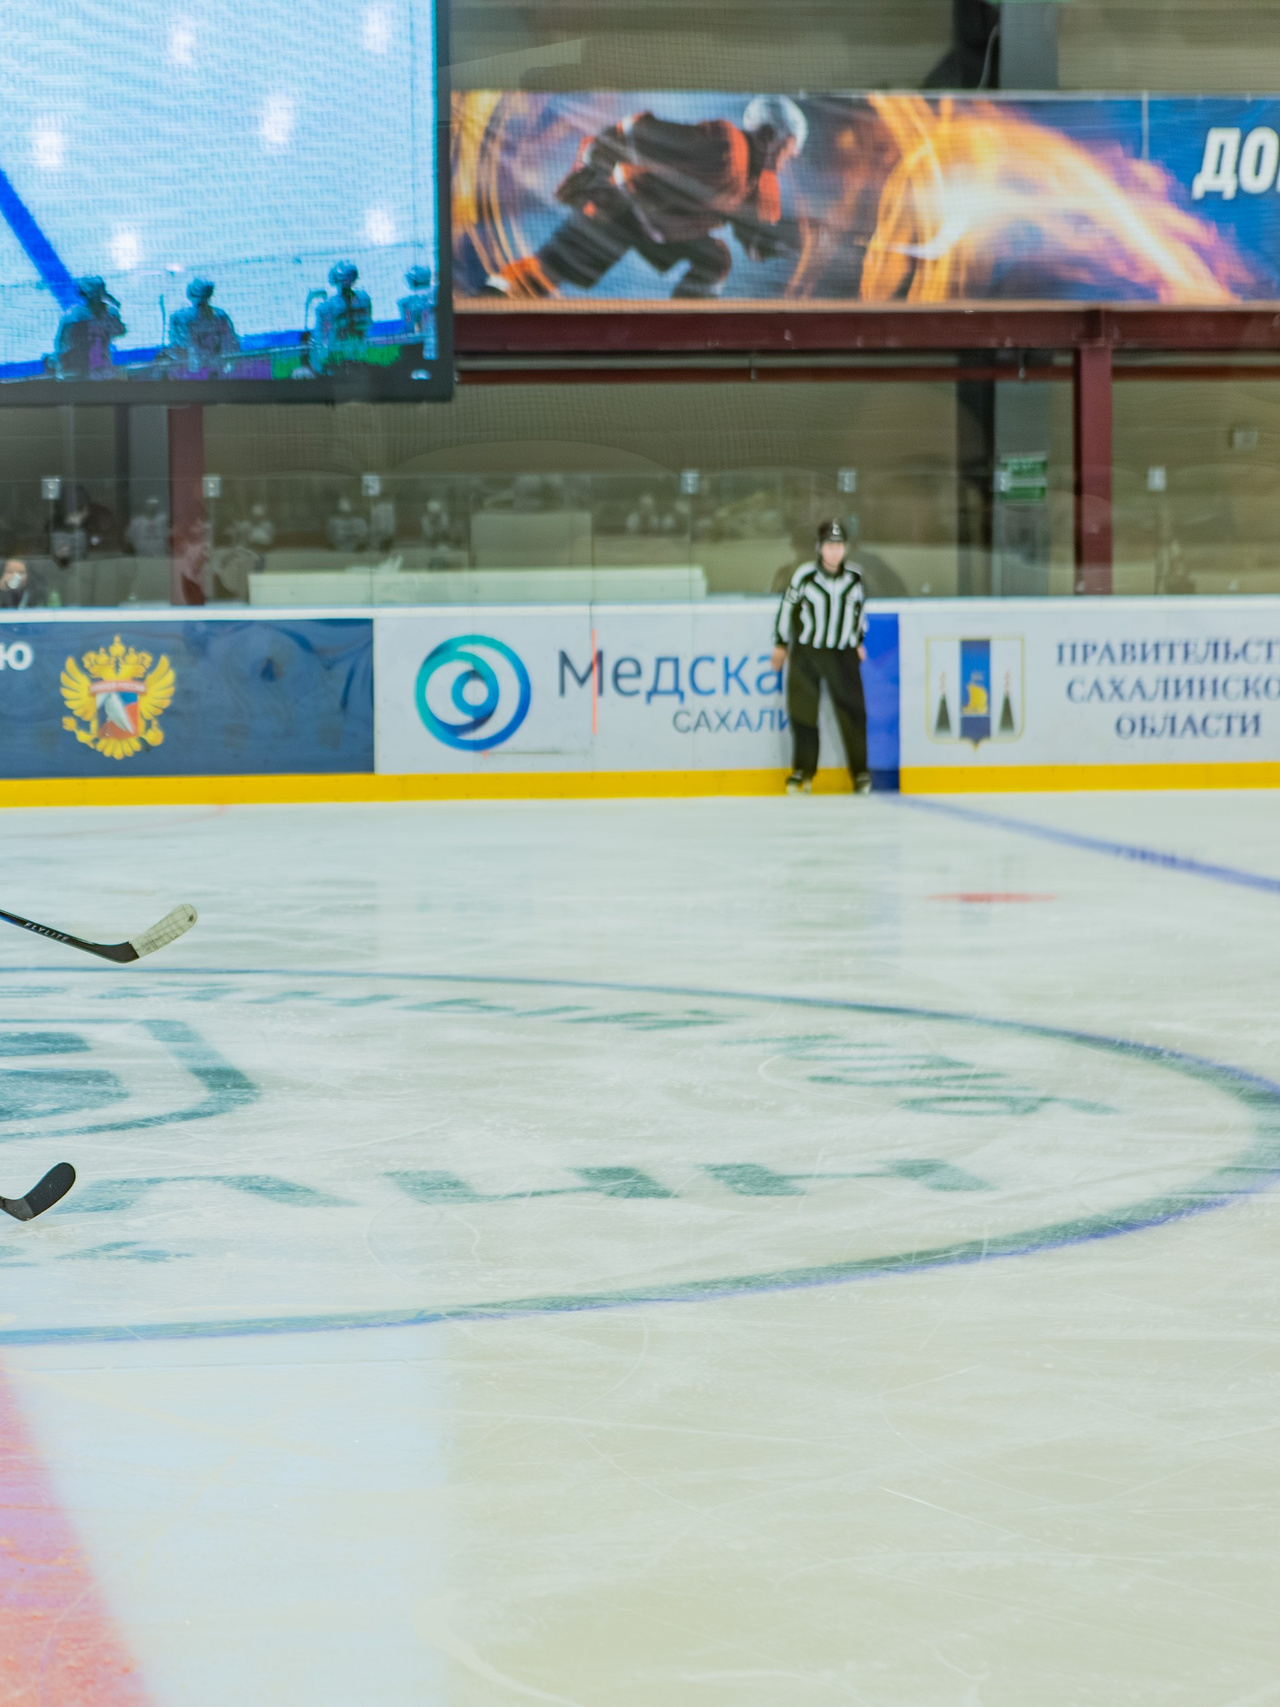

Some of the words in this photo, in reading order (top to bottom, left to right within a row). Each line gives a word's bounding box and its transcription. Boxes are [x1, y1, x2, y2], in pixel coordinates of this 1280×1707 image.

[1192, 126, 1280, 200] ДО
[558, 648, 784, 705] Медска
[672, 708, 792, 734] САХАЛИ
[1114, 711, 1263, 740] ОБЛАСТИ
